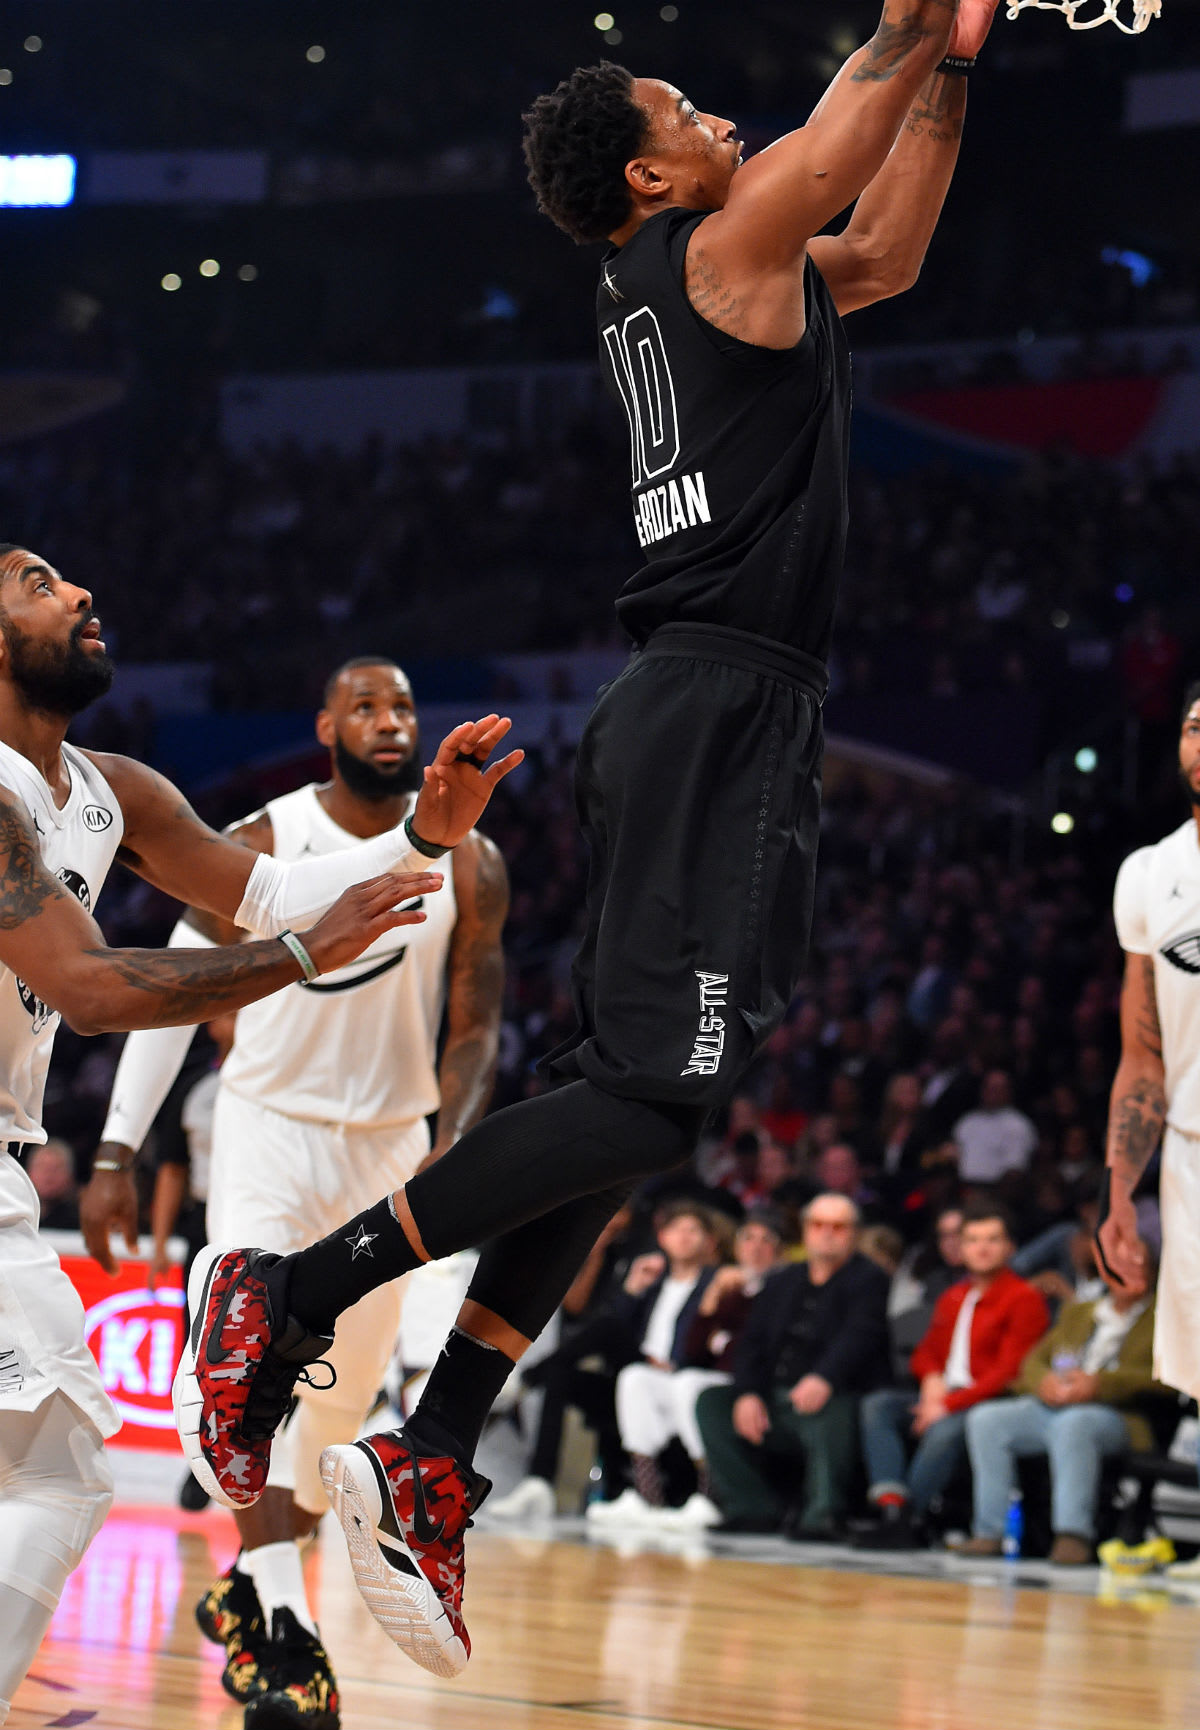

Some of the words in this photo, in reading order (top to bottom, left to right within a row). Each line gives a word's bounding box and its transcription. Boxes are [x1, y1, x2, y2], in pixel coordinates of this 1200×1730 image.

[602, 305, 681, 489] 10
[634, 471, 712, 548] EROZAN
[84, 810, 107, 826] KIA
[680, 970, 729, 1076] ALL-STAR
[101, 1316, 176, 1397] KI
